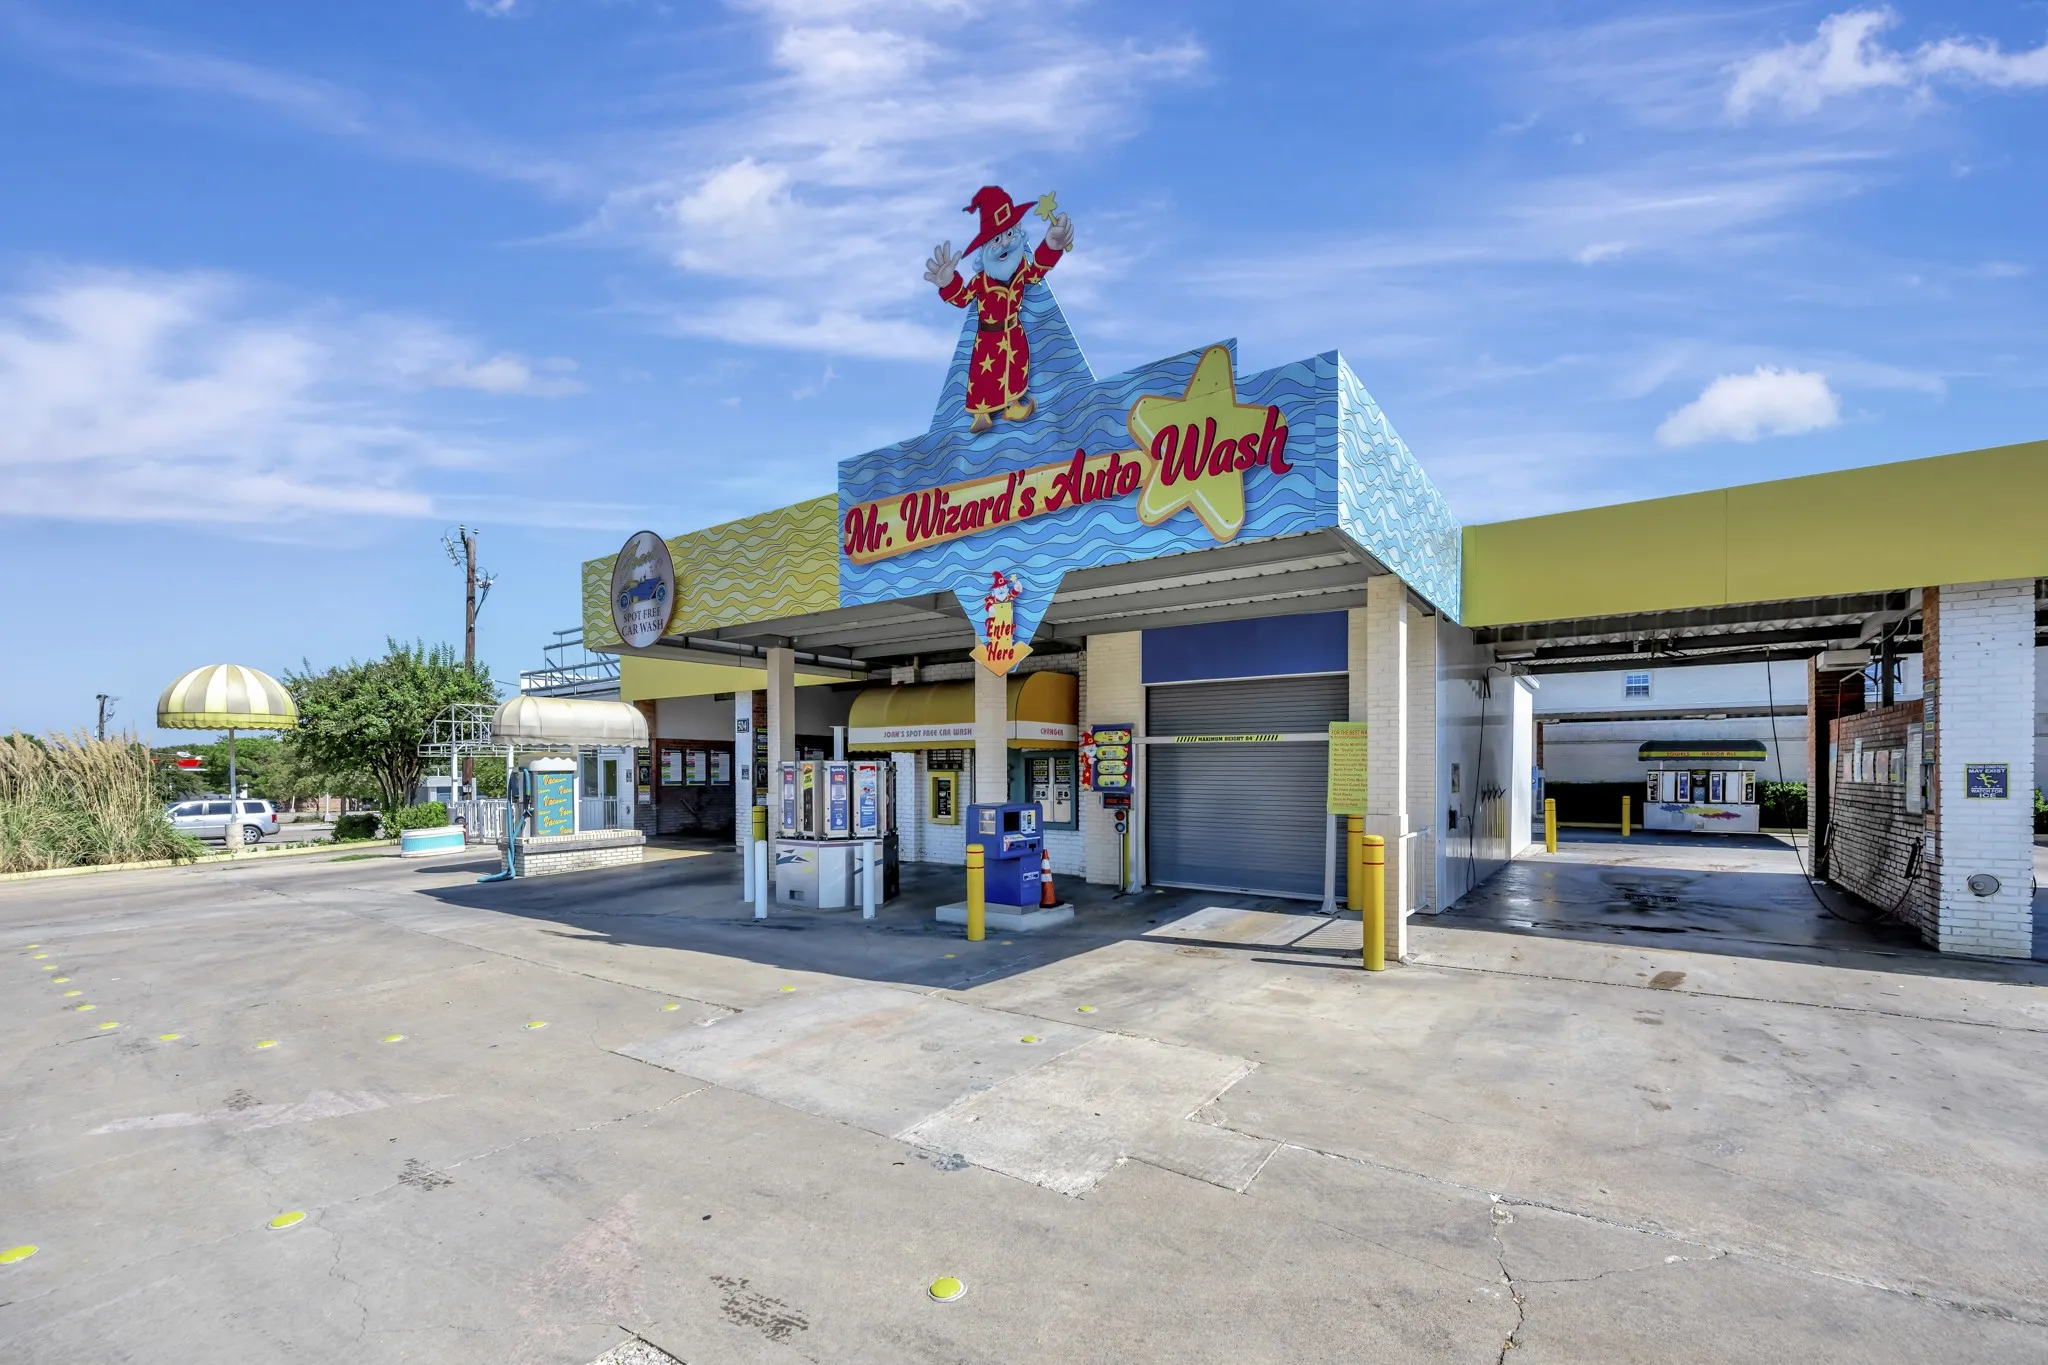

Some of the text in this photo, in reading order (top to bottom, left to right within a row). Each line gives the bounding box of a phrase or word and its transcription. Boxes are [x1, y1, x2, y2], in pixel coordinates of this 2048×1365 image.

[844, 405, 1294, 555] Mr. Wizard's Auto Wash
[623, 607, 661, 623] SPOT FREE
[621, 619, 664, 637] CAR WASH
[984, 617, 1017, 640] Enter
[986, 641, 1014, 661] Here
[906, 730, 921, 738] SPOT
[922, 729, 938, 737] FREE
[953, 728, 972, 736] WASH
[1040, 728, 1064, 736] CHANGER
